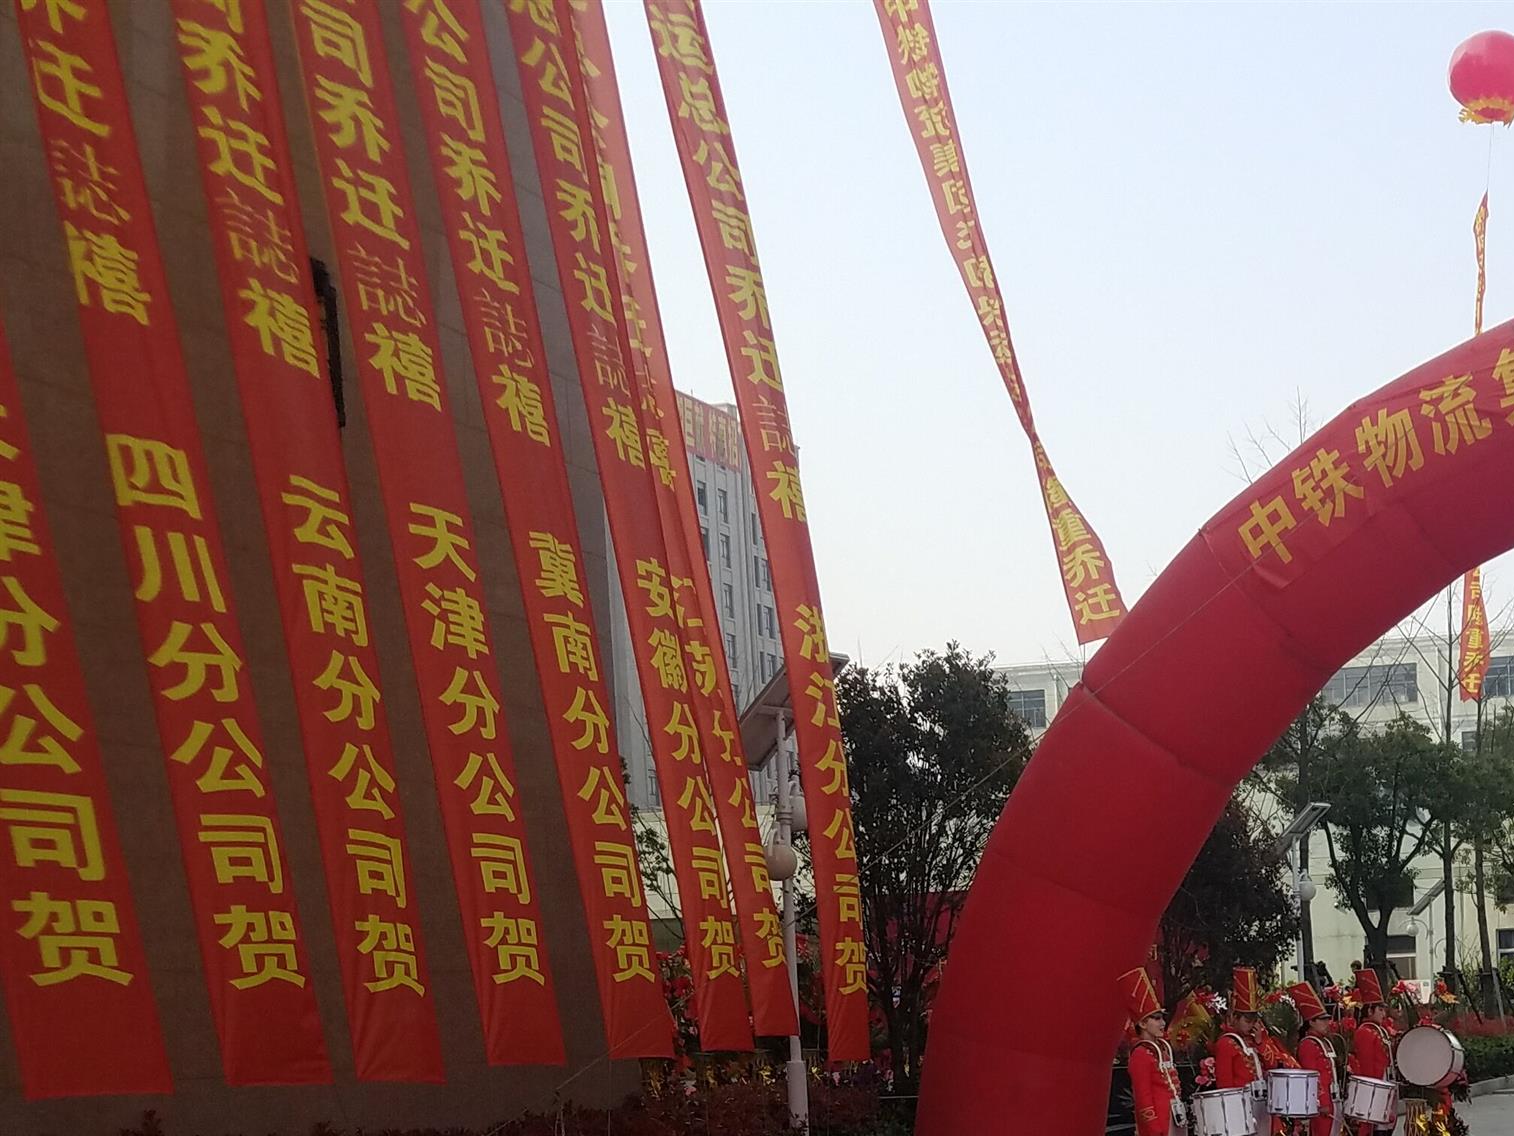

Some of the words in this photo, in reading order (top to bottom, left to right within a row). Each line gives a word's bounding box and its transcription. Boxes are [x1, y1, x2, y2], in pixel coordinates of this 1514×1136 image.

[105, 432, 306, 990] 四川分公司贺
[280, 474, 426, 997] 云南分公司贺
[407, 502, 546, 987] 天津分公司贺
[528, 530, 657, 984] 冀南分公司贺
[635, 558, 742, 981] 安徽分公司贺
